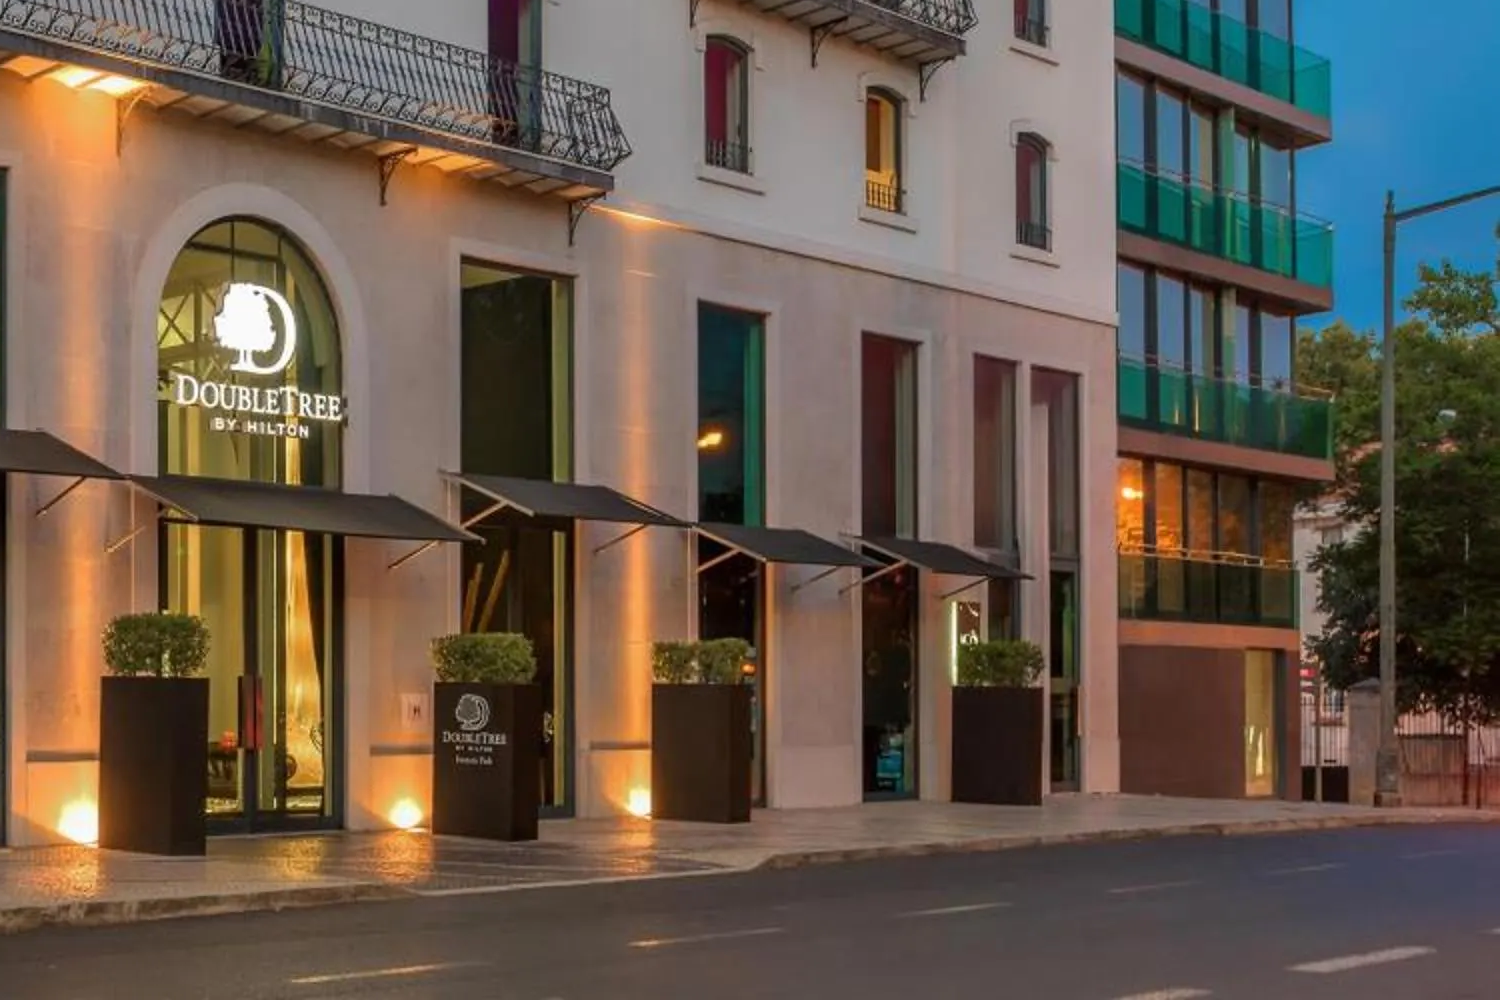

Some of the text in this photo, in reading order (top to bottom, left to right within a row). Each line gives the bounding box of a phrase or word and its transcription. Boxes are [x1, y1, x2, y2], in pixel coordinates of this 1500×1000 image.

[176, 374, 343, 421] DOUBLETREE
[211, 416, 310, 438] BY HILTON
